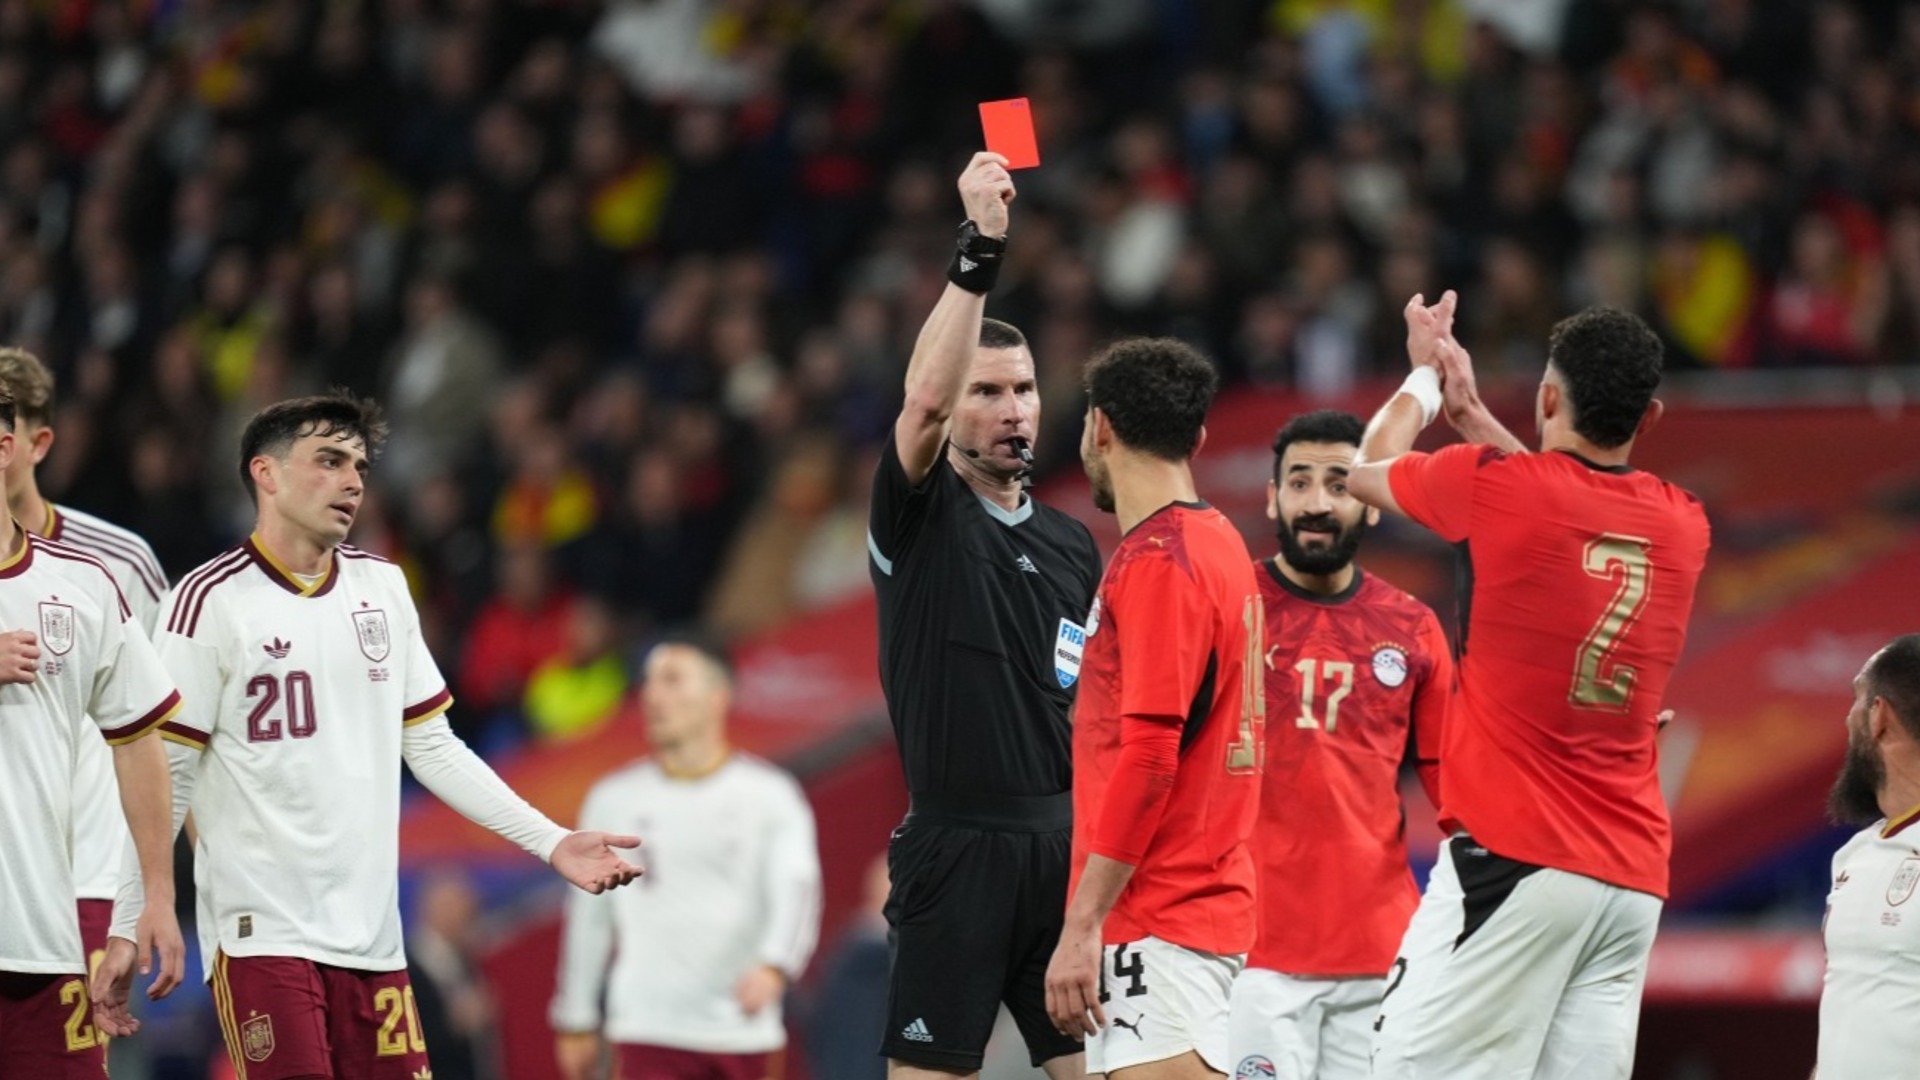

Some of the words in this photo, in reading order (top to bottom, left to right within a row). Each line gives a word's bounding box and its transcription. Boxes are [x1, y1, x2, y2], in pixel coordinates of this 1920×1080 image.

[1061, 623, 1085, 647] FIFA
[1567, 532, 1653, 714] 2
[246, 671, 317, 743] 20
[1294, 658, 1354, 732] 17
